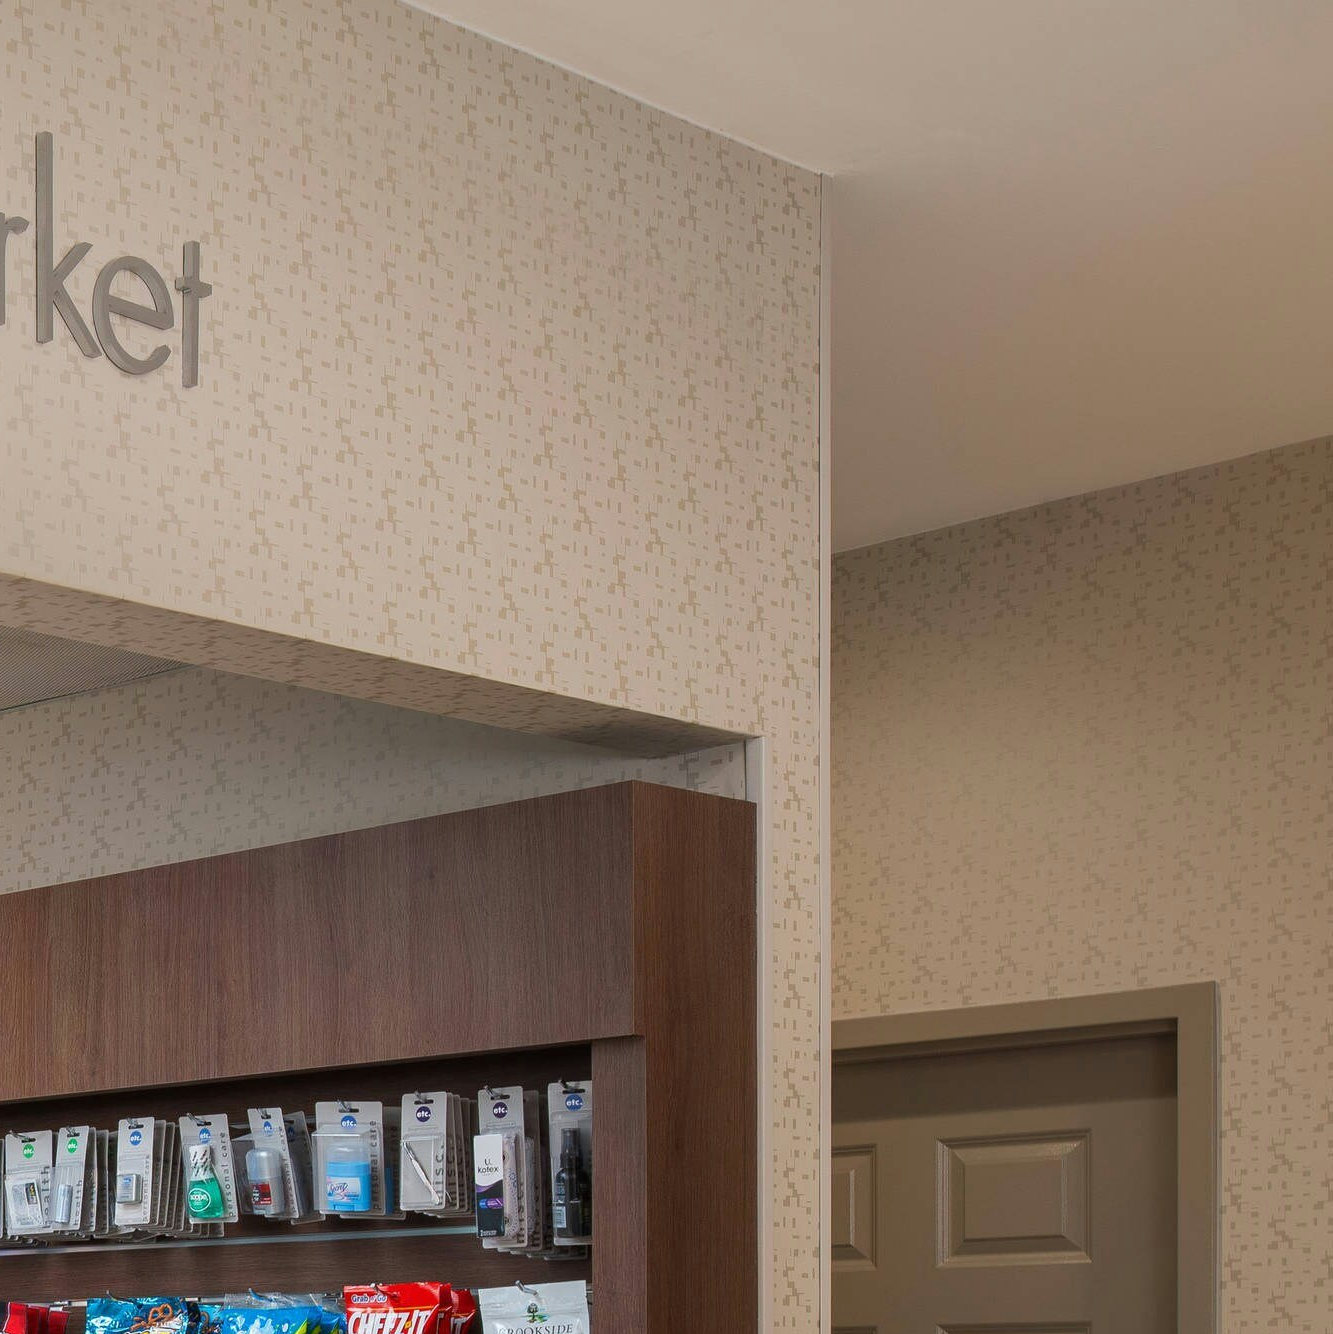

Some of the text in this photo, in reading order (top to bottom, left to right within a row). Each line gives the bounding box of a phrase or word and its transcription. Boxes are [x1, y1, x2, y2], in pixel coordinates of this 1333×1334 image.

[565, 1098, 583, 1107] etc.
[416, 1110, 431, 1119] etc.
[492, 1106, 509, 1115] etc.
[341, 1119, 357, 1128] etc.
[369, 1120, 381, 1210] personal care
[219, 1132, 237, 1218] personal care
[351, 1293, 388, 1304] Grab Go
